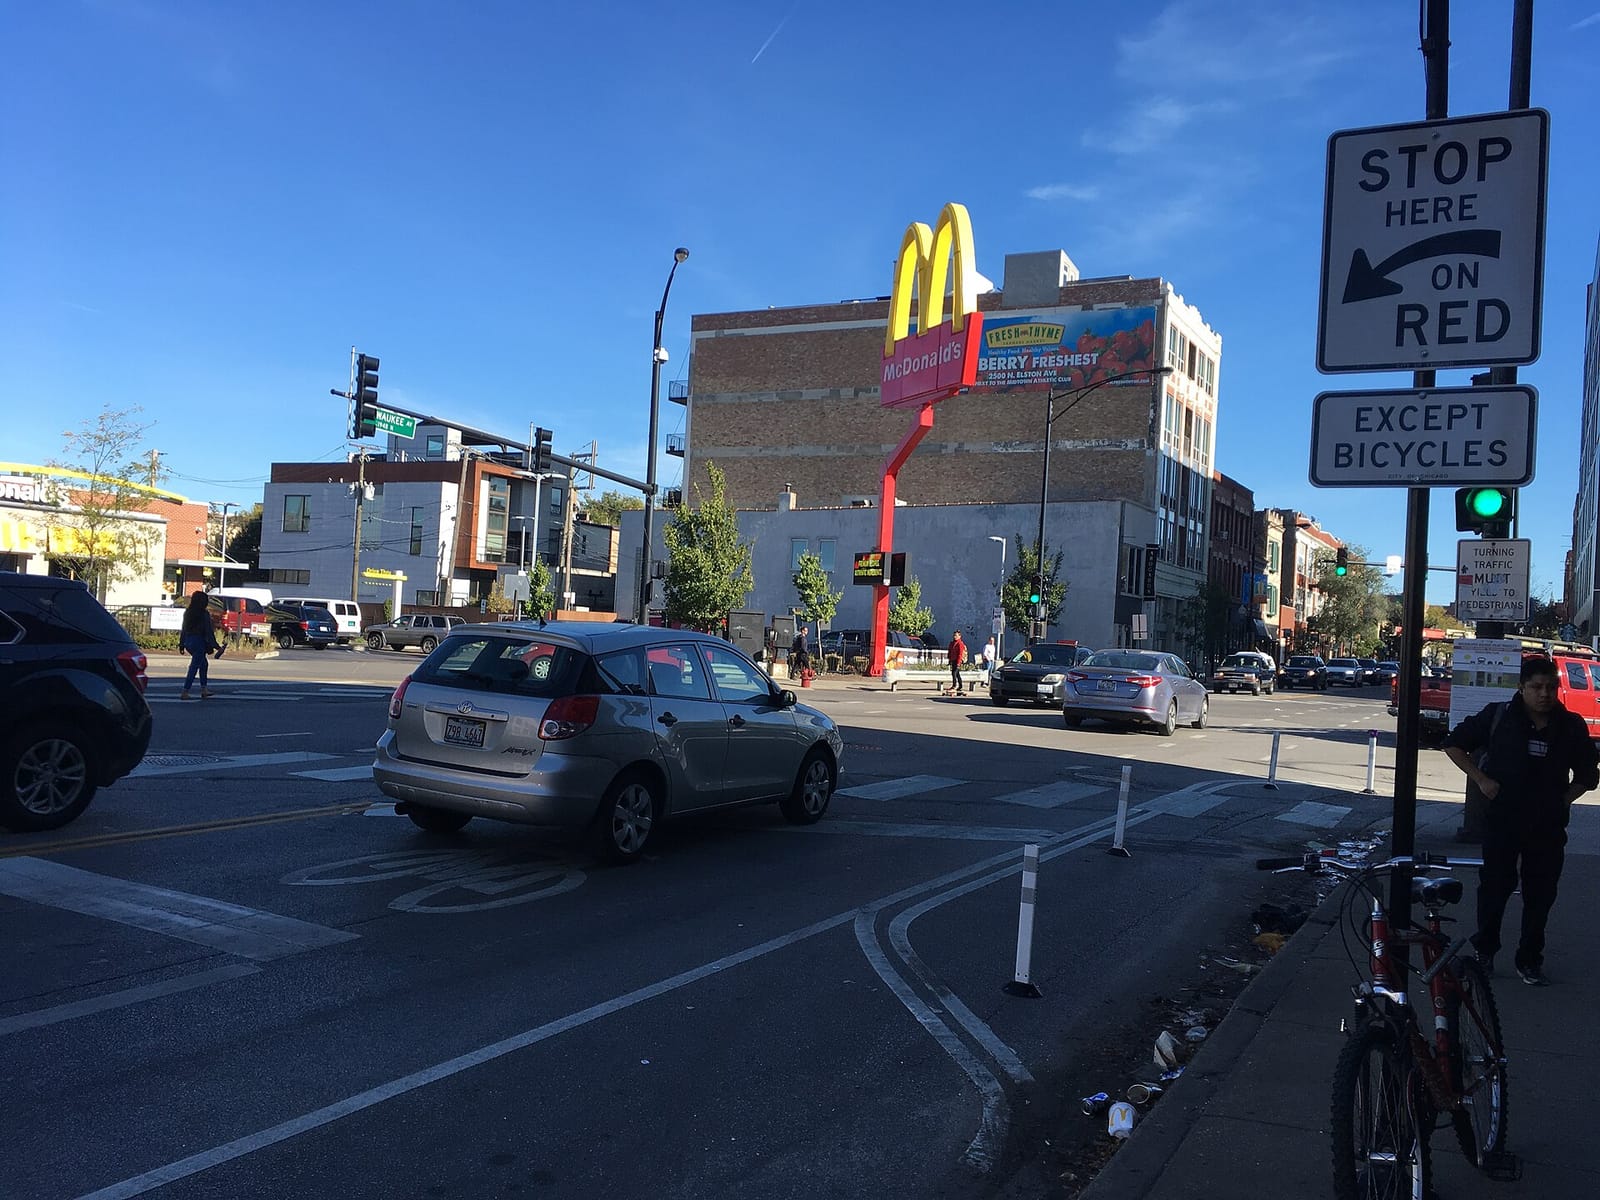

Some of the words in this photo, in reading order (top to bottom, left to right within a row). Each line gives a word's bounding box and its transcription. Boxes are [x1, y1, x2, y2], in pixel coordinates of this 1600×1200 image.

[1358, 136, 1512, 192] STOP
[1385, 193, 1478, 227] HERE
[1431, 262, 1479, 290] ON
[1395, 298, 1511, 347] RED
[989, 327, 1020, 343] FRESH
[1029, 326, 1061, 340] THYME
[883, 341, 962, 382] McDonald's
[978, 355, 1028, 371] BERRY
[1032, 352, 1099, 368] FRESHEST
[988, 372, 1006, 380] 2500
[1016, 370, 1042, 379] ELSTON
[1355, 403, 1489, 432] EXCEPT
[1334, 440, 1507, 468] BICYCLES
[1474, 548, 1514, 556] TURNING
[1474, 561, 1512, 569] TRAFFIC
[1503, 588, 1515, 597] TO
[1461, 600, 1524, 610] PEDESTRIANS
